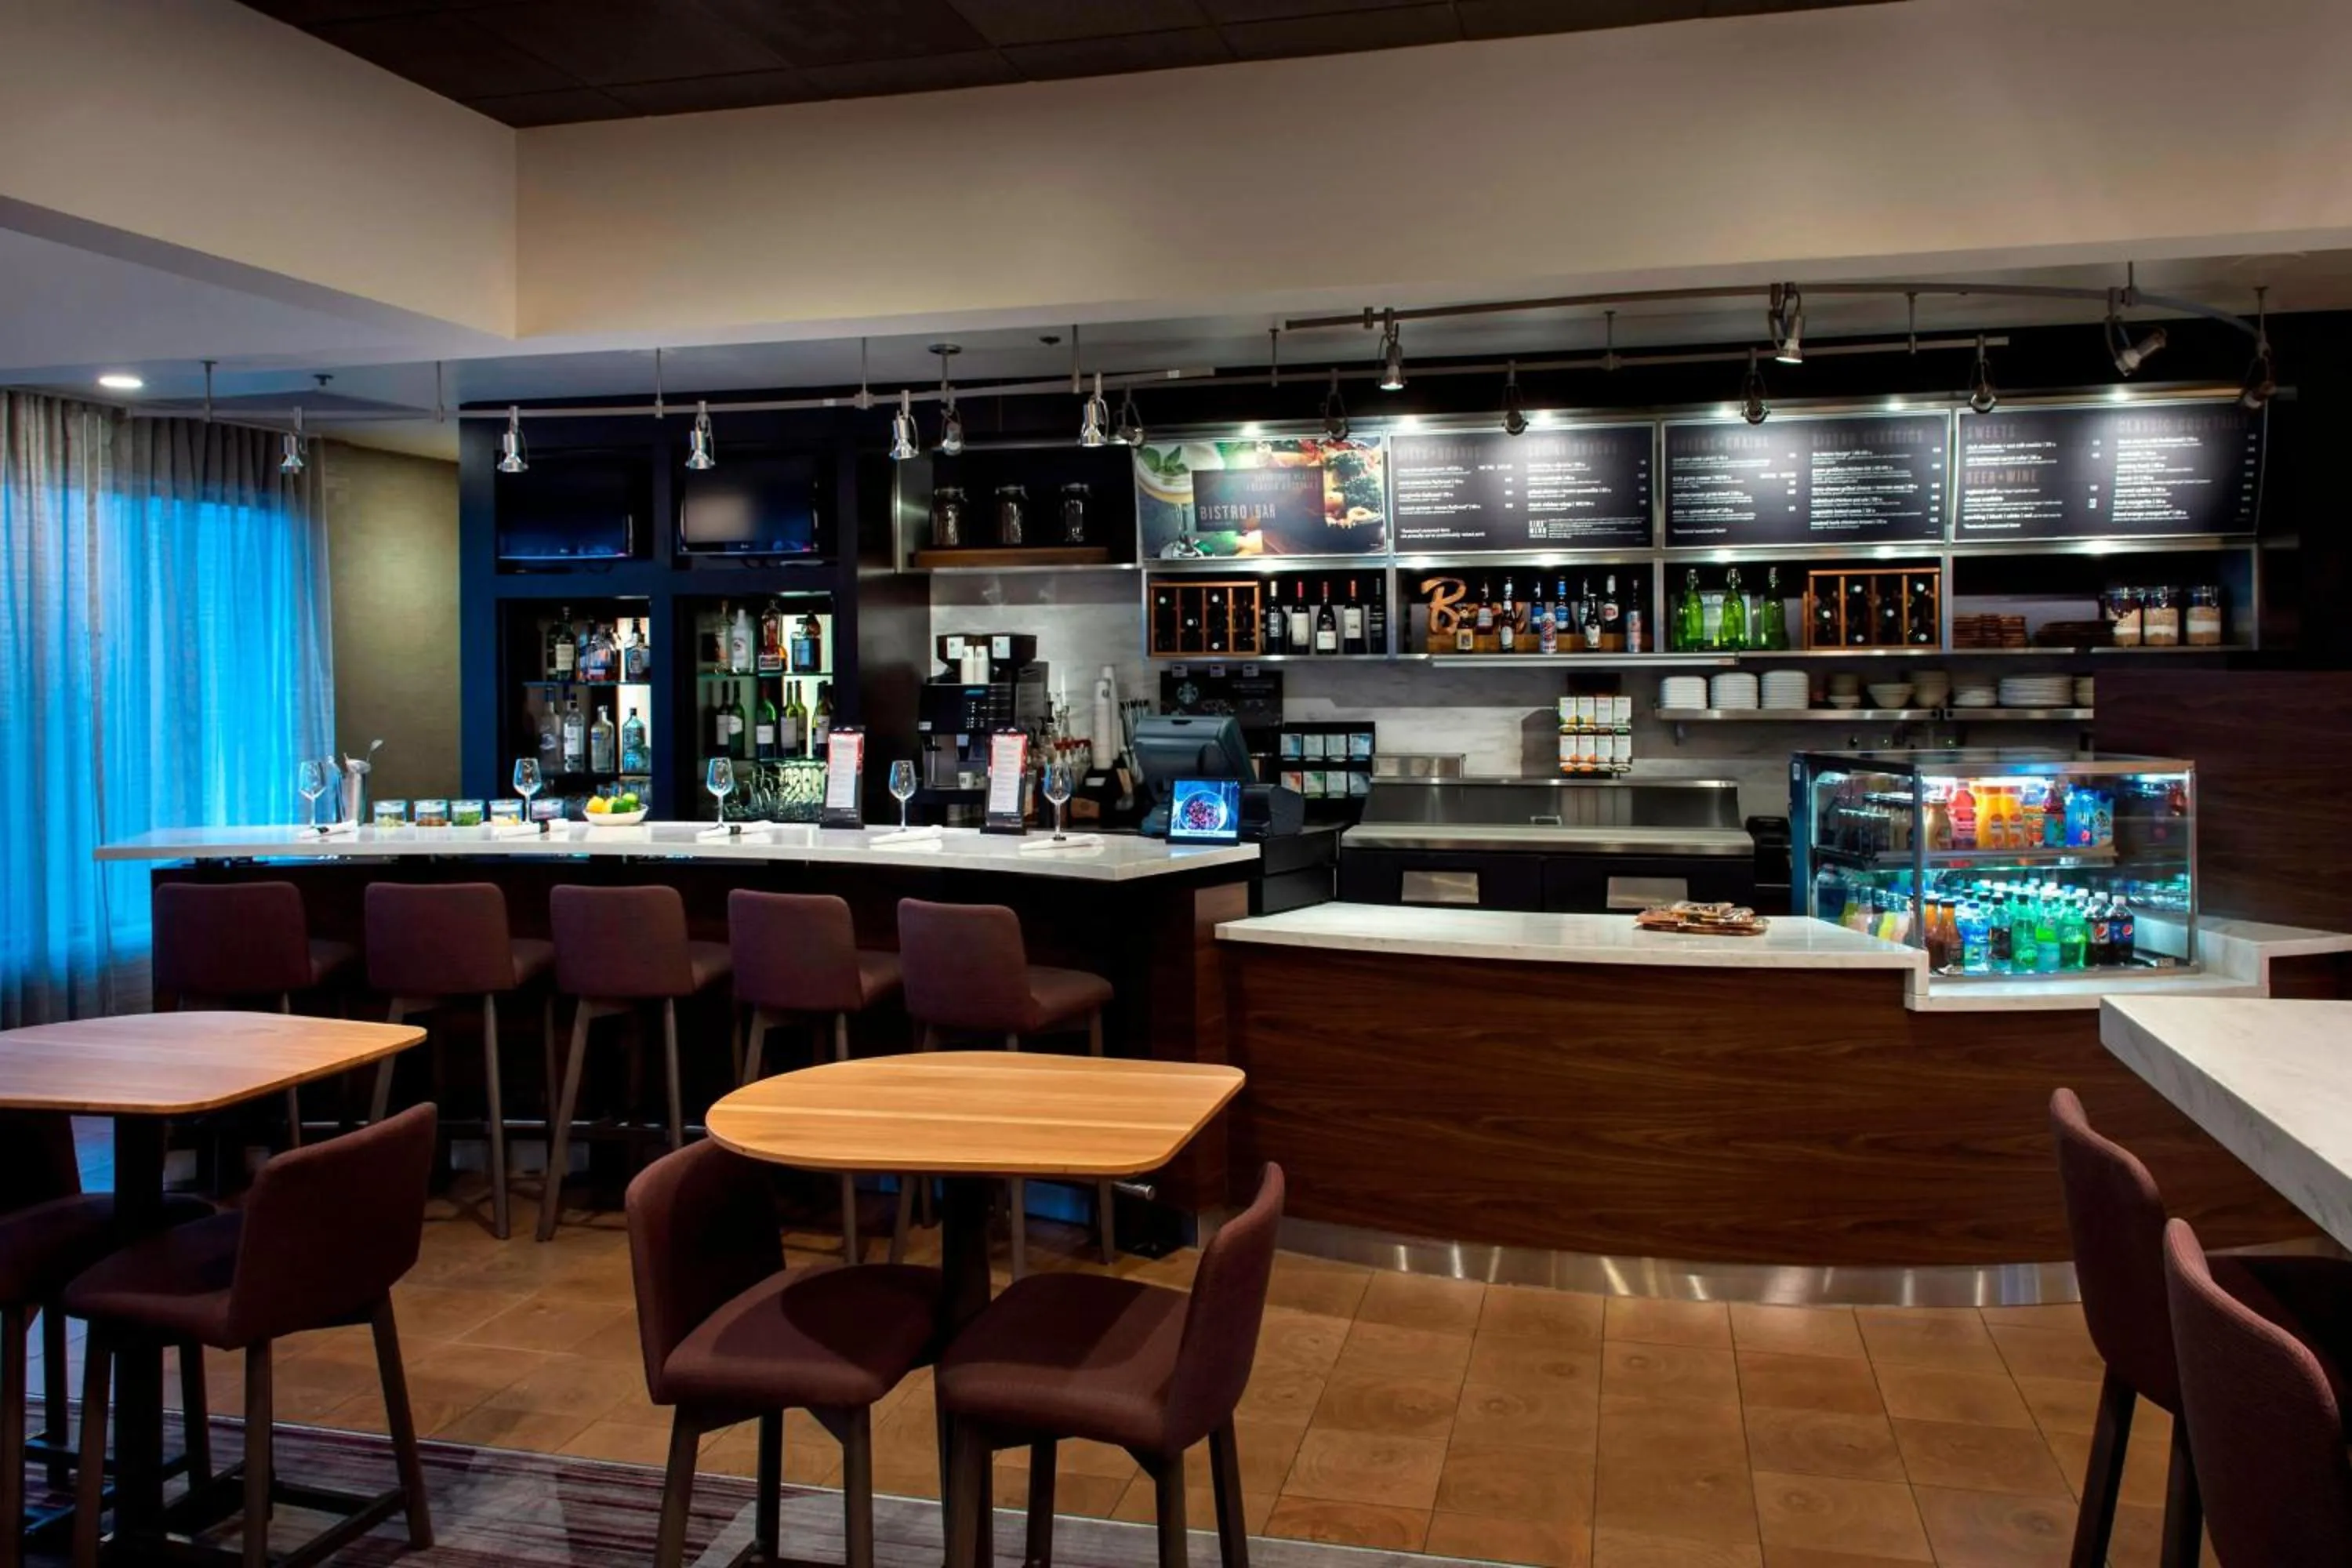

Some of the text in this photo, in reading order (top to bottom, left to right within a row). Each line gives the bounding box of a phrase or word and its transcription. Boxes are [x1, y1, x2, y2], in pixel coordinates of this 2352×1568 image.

[1966, 425, 2016, 441] SWEETS
[1200, 503, 1276, 521] BISTRO BAR
